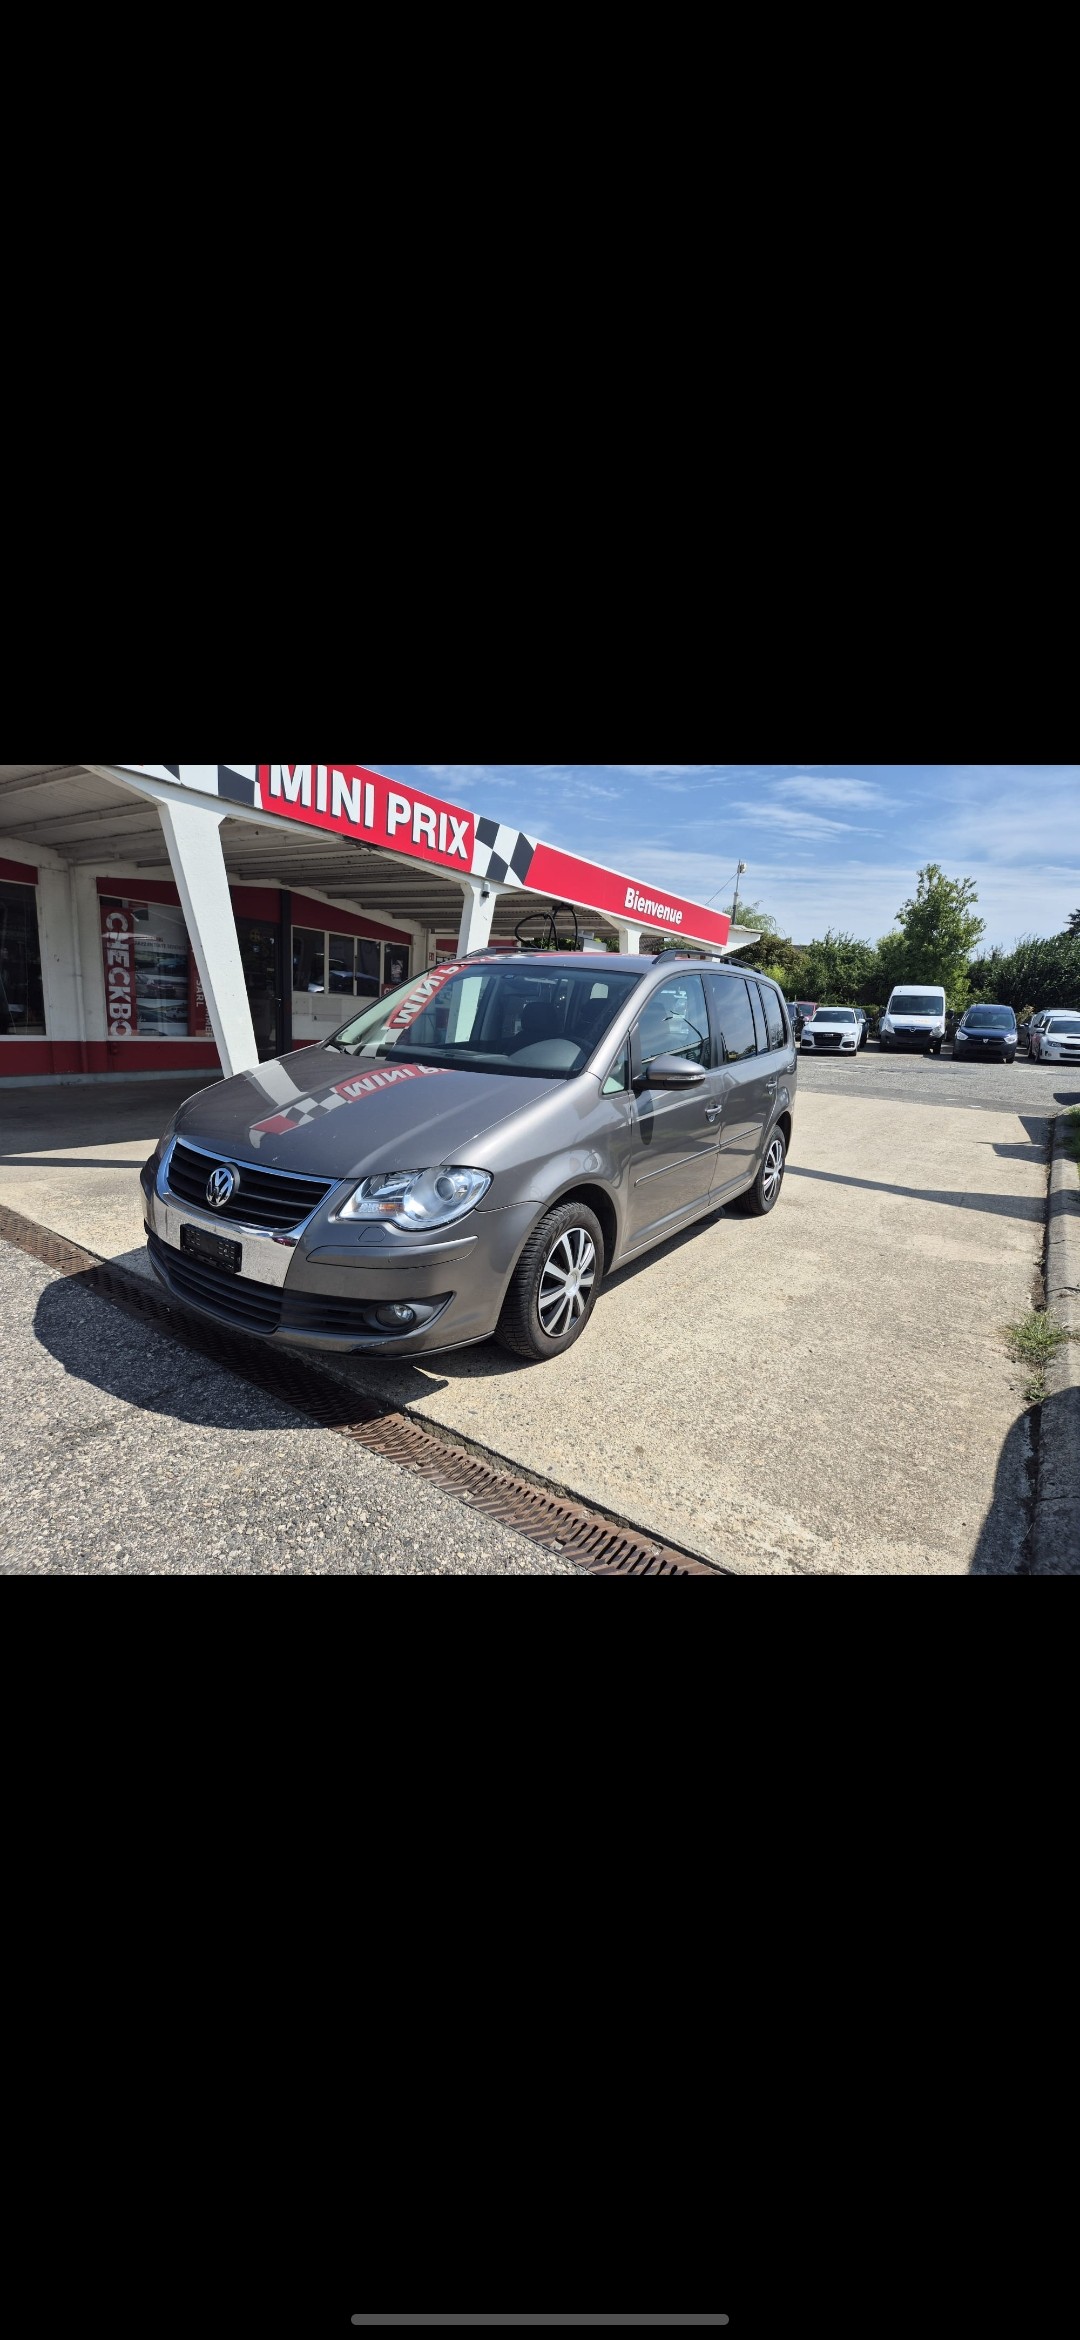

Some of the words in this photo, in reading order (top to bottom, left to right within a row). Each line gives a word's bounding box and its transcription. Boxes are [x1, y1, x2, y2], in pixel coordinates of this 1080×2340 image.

[269, 765, 375, 829] MINI
[386, 792, 469, 859] PRIX
[624, 886, 683, 925] Bienvenue
